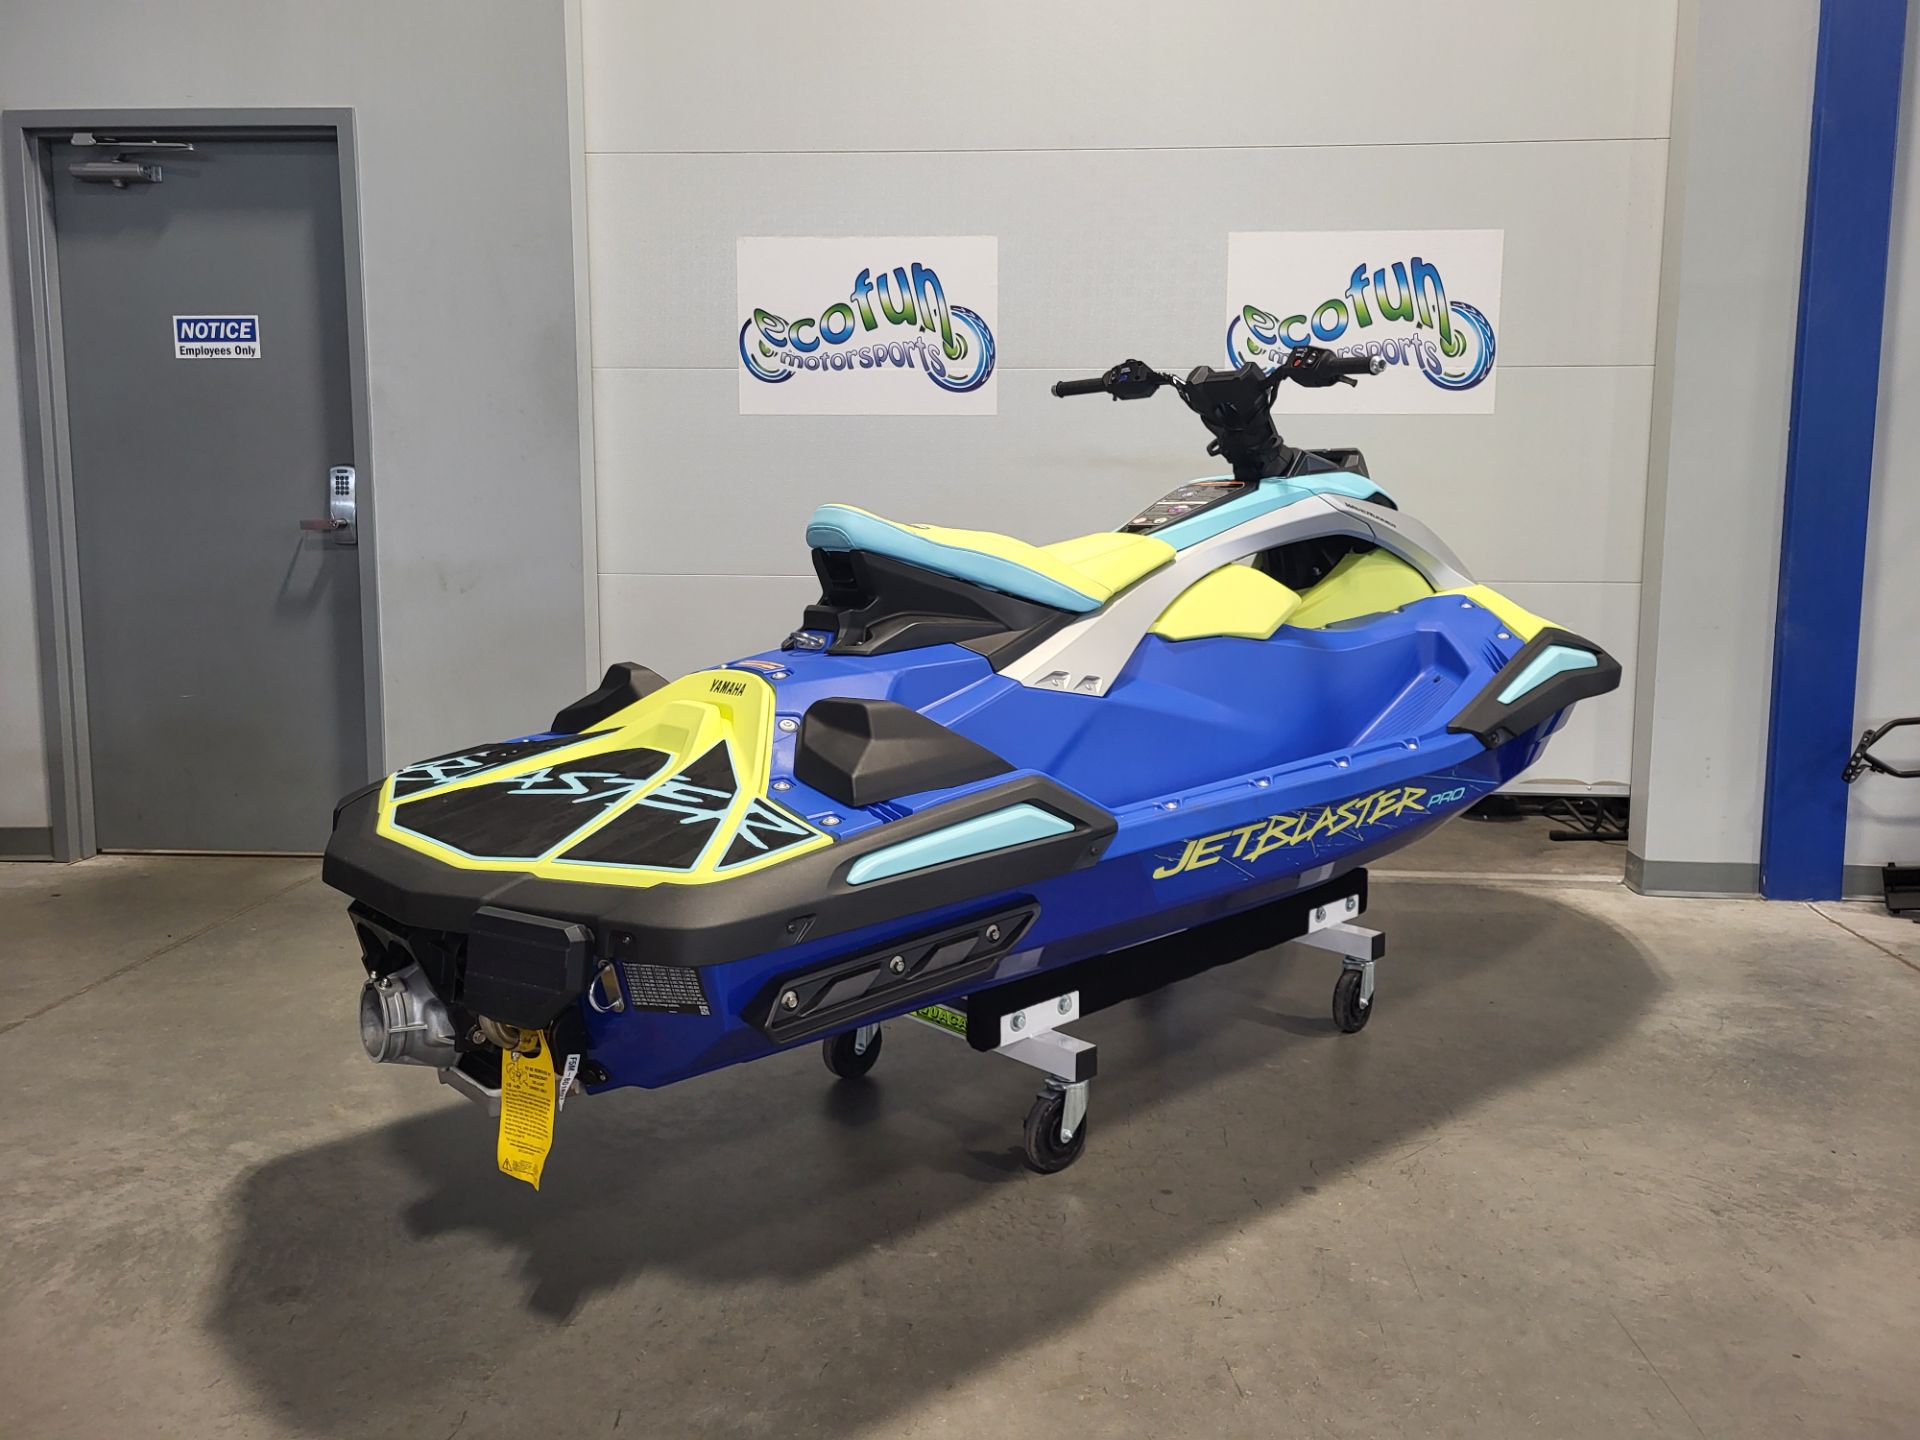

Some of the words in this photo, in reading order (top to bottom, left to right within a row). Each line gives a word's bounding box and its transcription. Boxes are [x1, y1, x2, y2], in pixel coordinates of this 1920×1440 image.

[180, 322, 252, 338] NOTICE
[179, 345, 232, 357] Employees
[234, 345, 256, 356] Only
[780, 336, 946, 378] motorsports
[1268, 332, 1443, 376] mrsports
[709, 679, 747, 696] YAMAHA
[1152, 786, 1427, 880] JETBLASTER
[1427, 787, 1466, 808] PRO
